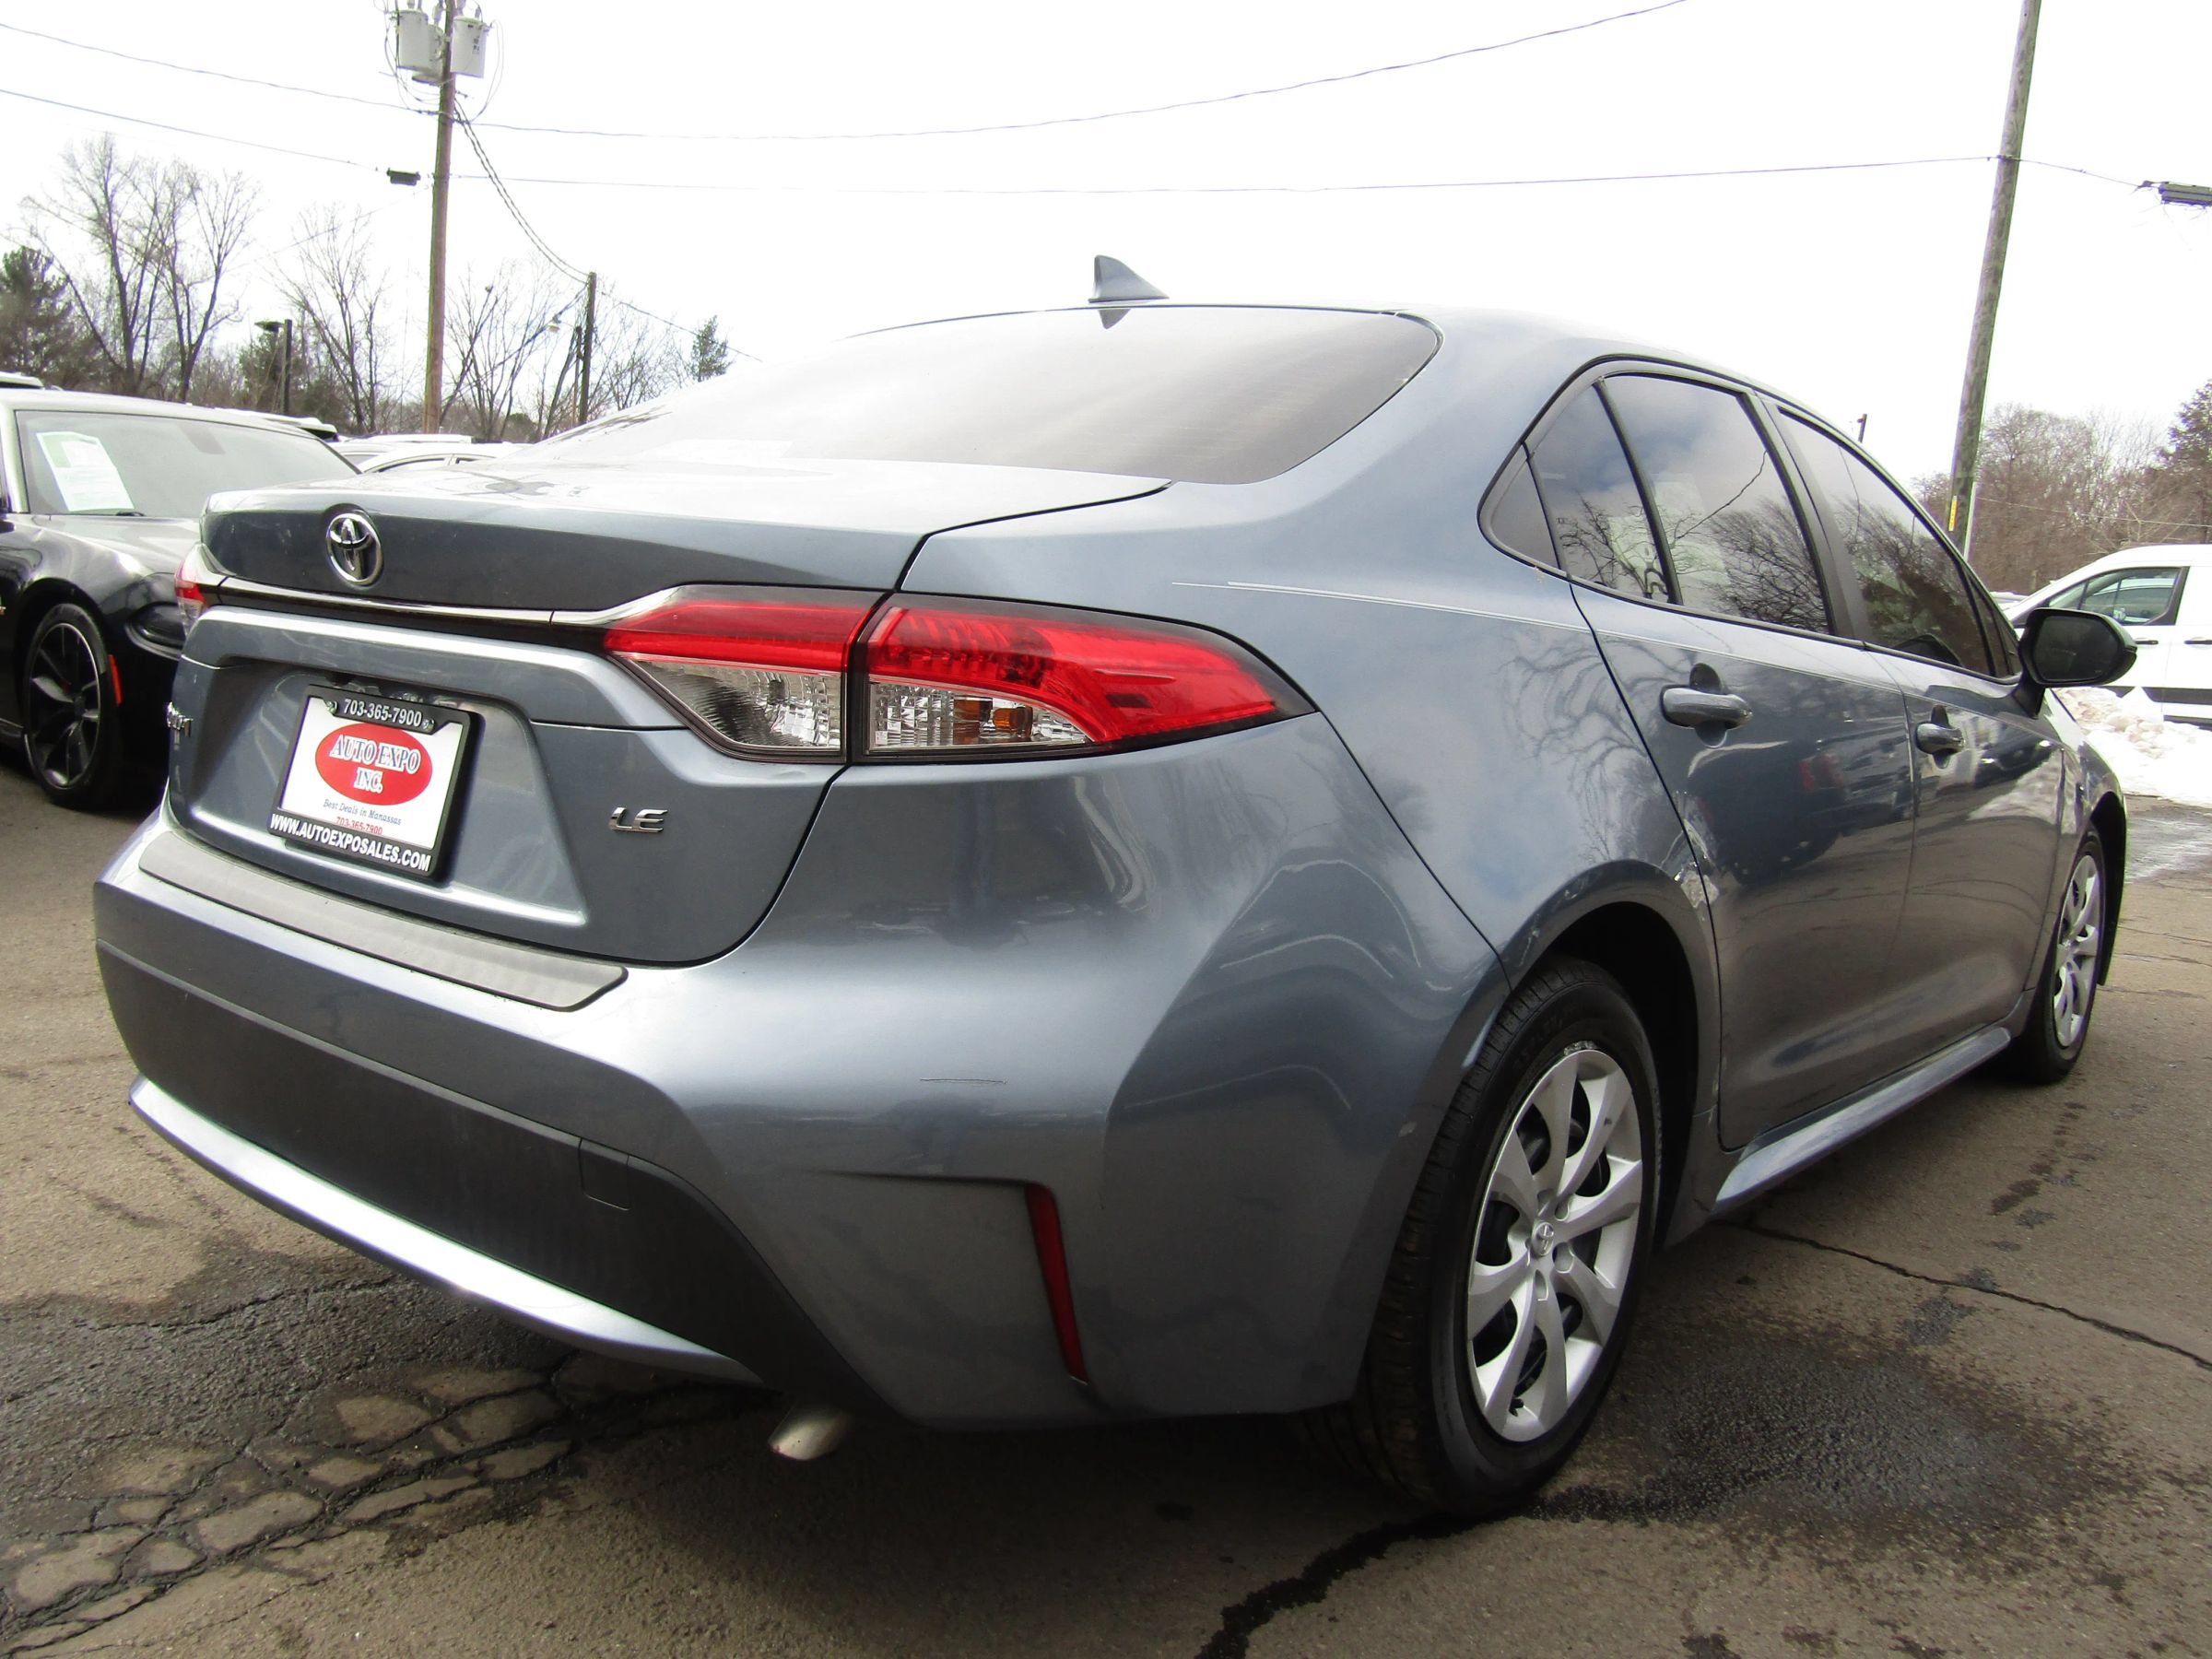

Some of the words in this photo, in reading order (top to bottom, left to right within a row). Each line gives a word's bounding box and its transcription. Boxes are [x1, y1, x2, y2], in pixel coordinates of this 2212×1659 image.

[344, 699, 422, 727] 703-365-7900
[332, 735, 377, 764] AUTO
[376, 743, 421, 773] EXPO
[355, 768, 382, 793] INC.
[323, 798, 338, 809] Best
[339, 803, 359, 815] Deals
[359, 806, 368, 817] in
[368, 809, 403, 826] Manassas
[336, 817, 383, 835] 703-365-7900
[608, 806, 668, 833] LE
[270, 814, 431, 872] WWW.AUTOEXPOSALES.COM
